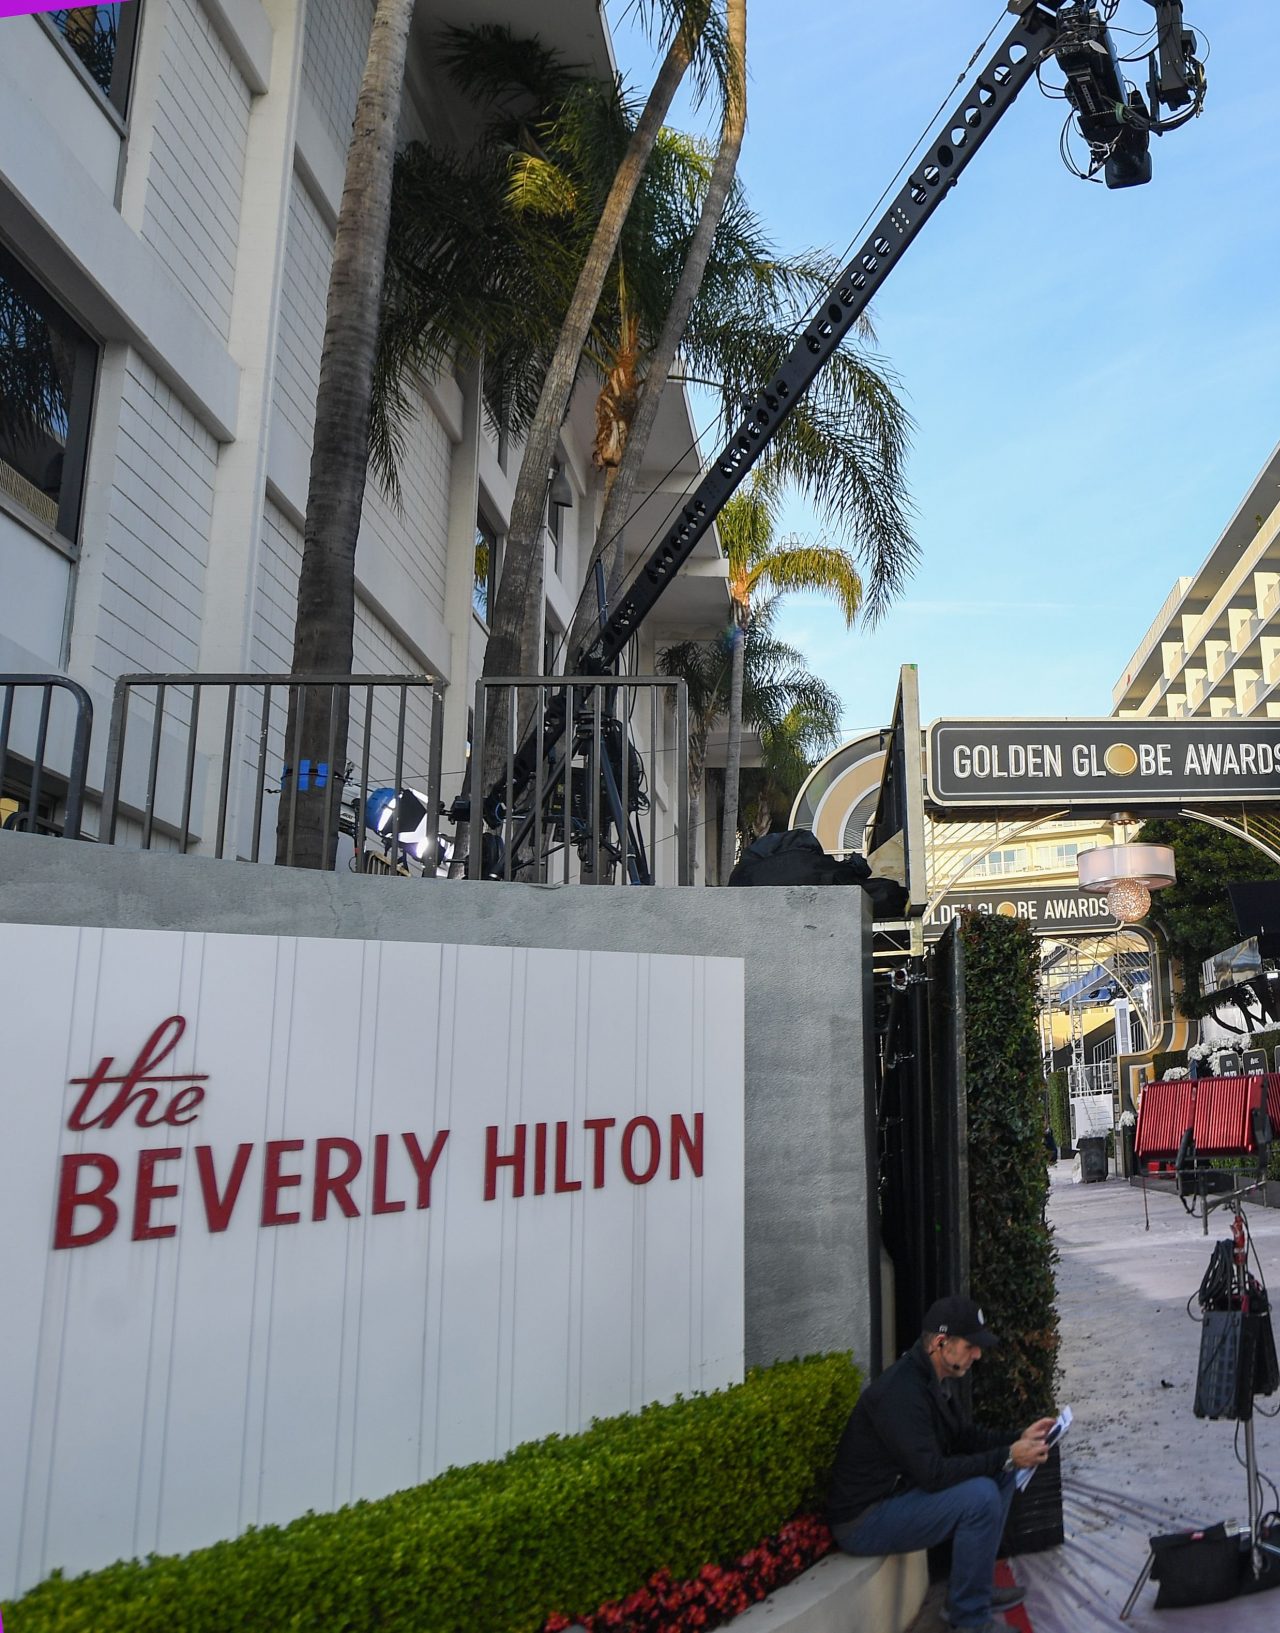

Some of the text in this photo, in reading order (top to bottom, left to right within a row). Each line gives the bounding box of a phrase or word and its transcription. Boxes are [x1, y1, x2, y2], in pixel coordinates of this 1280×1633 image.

[953, 744, 1062, 778] GOLDEN
[1073, 742, 1173, 777] GLOBE
[1044, 897, 1111, 919] AWARDS
[66, 1015, 210, 1133] the
[53, 1112, 704, 1251] BEVERLY HILTON
